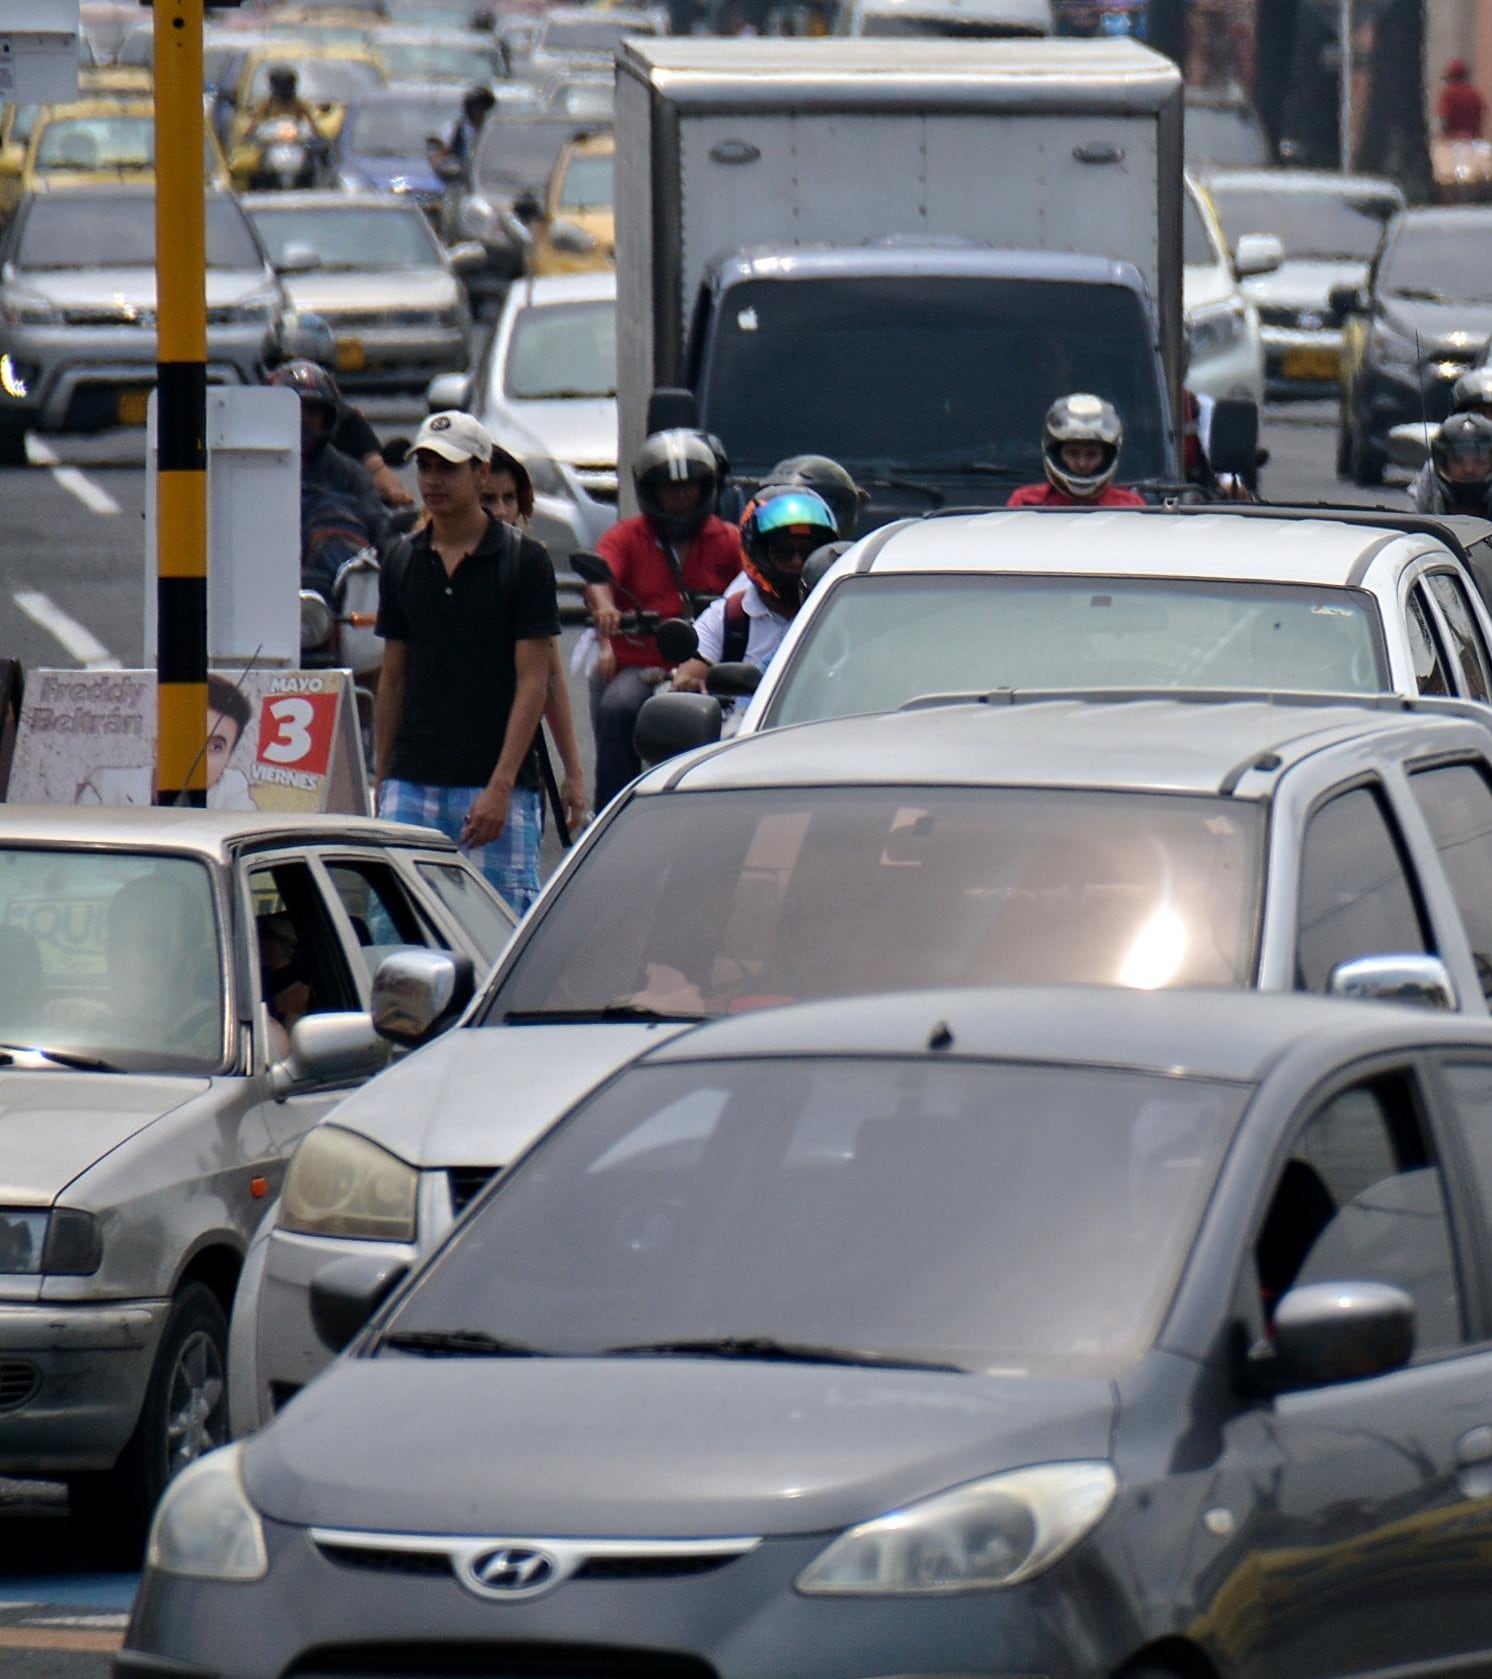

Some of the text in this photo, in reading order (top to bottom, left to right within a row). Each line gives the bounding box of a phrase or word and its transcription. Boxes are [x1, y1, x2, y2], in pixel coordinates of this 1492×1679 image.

[40, 676, 146, 708] Freddy
[270, 677, 324, 693] MAYO
[262, 697, 314, 763] 3
[251, 763, 319, 791] VIERNES
